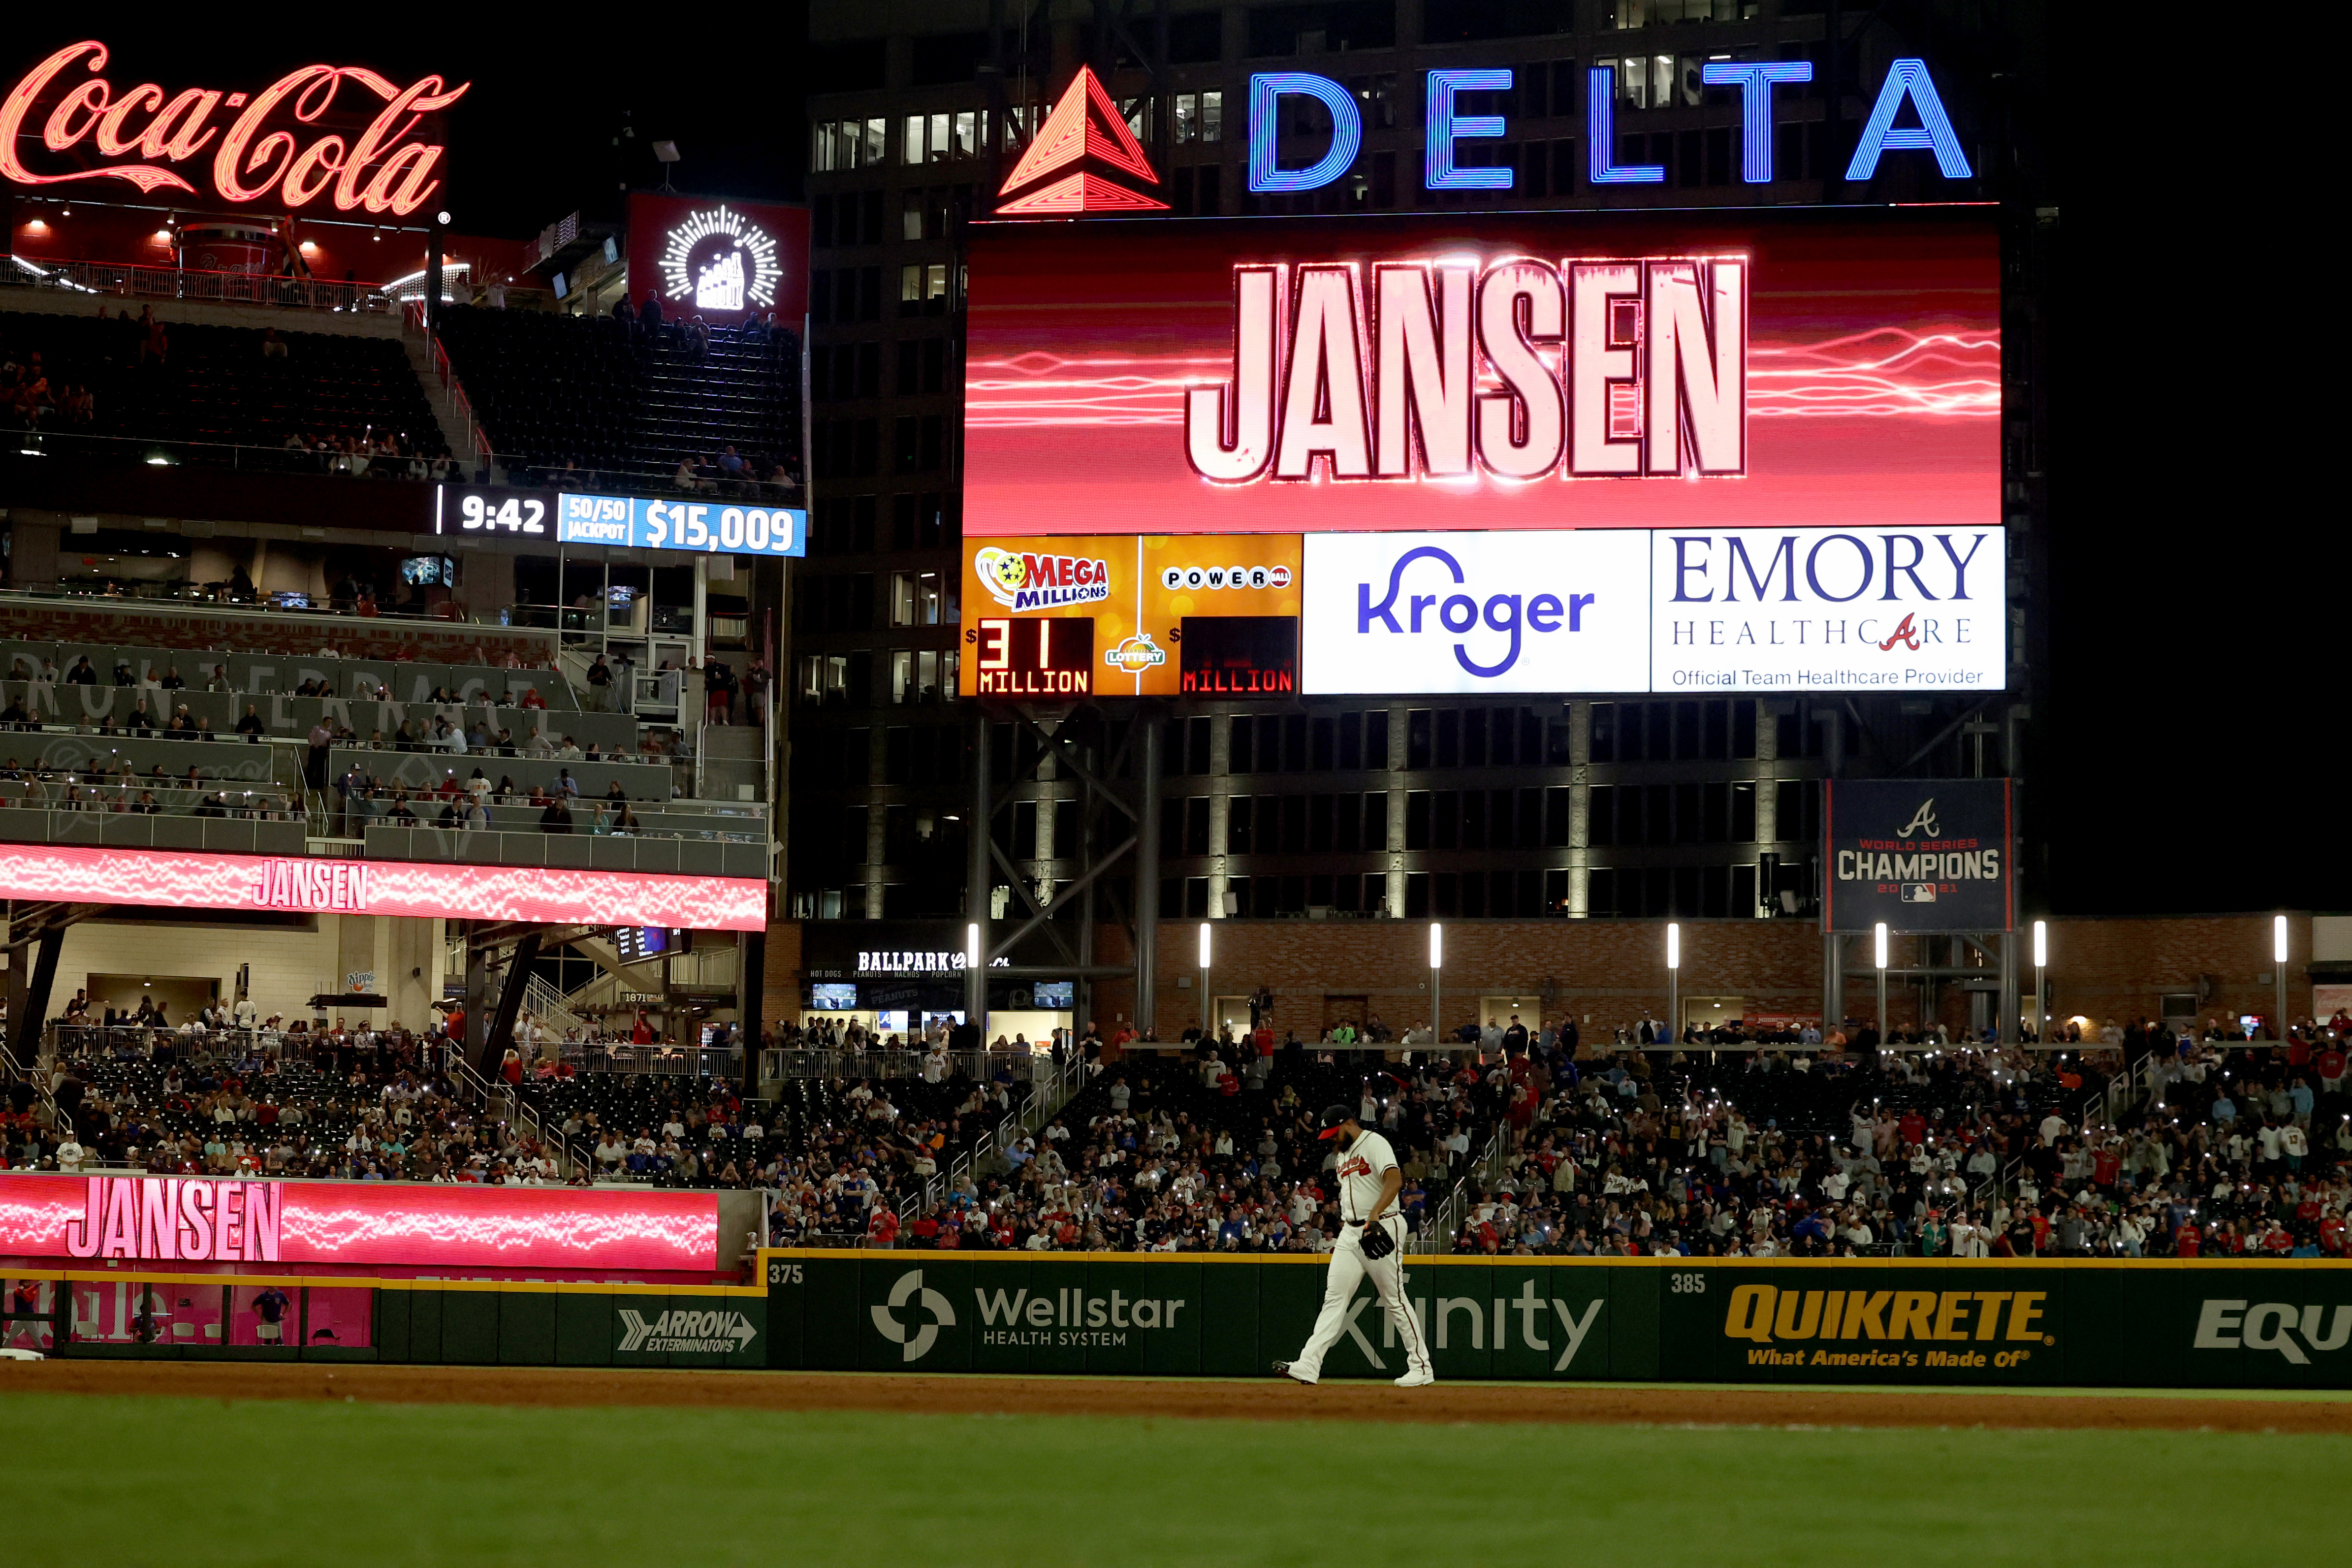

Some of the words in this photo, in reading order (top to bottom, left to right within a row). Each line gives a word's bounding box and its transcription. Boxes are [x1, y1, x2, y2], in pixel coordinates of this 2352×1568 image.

[0, 40, 471, 215] Coca-Cola
[1249, 58, 1973, 192] DELTA
[1183, 254, 1748, 486] JANSEN
[462, 496, 544, 533] 9:42
[569, 497, 626, 521] 50/50
[567, 519, 626, 541] JACKPOT
[646, 499, 794, 552] $15,009
[1019, 555, 1107, 589] MEGA
[1668, 533, 1988, 603] EMORY
[1015, 585, 1107, 610] MILLIONS
[1357, 545, 1595, 678] Kroger
[1109, 652, 1162, 662] LOTTERY
[980, 671, 1087, 693] MILLION
[1183, 669, 1292, 692] MILLION
[1673, 670, 1737, 685] Official
[1742, 670, 1791, 685] Team
[1798, 670, 1899, 685] Healthcare
[1905, 669, 1983, 684] Provider
[1859, 838, 1916, 851] WORLD
[1920, 838, 1979, 851] SERIES
[1838, 848, 2000, 881] CHAMPIONS
[251, 860, 368, 910] JANSEN
[1877, 883, 1899, 894] 20
[1939, 883, 1958, 894] 21
[858, 952, 950, 971] BALLPARK
[625, 993, 646, 1002] 1871
[2288, 1134, 2298, 1145] 13
[65, 1176, 282, 1262] JANSEN
[768, 1264, 803, 1284] 375
[1671, 1273, 1706, 1294] 385
[975, 1287, 1185, 1329] Wellstar
[1724, 1284, 2047, 1343] QUIKRETE
[649, 1310, 739, 1338] ARROW
[2193, 1299, 2352, 1364] EQU
[646, 1338, 736, 1353] EXTERMINATORS
[984, 1331, 1051, 1346] HEALTH
[1058, 1331, 1126, 1346] SYSTEM
[1748, 1349, 1805, 1366] What
[1815, 1349, 1918, 1367] America's
[1925, 1350, 1986, 1367] Made
[1994, 1350, 2020, 1368] Of
